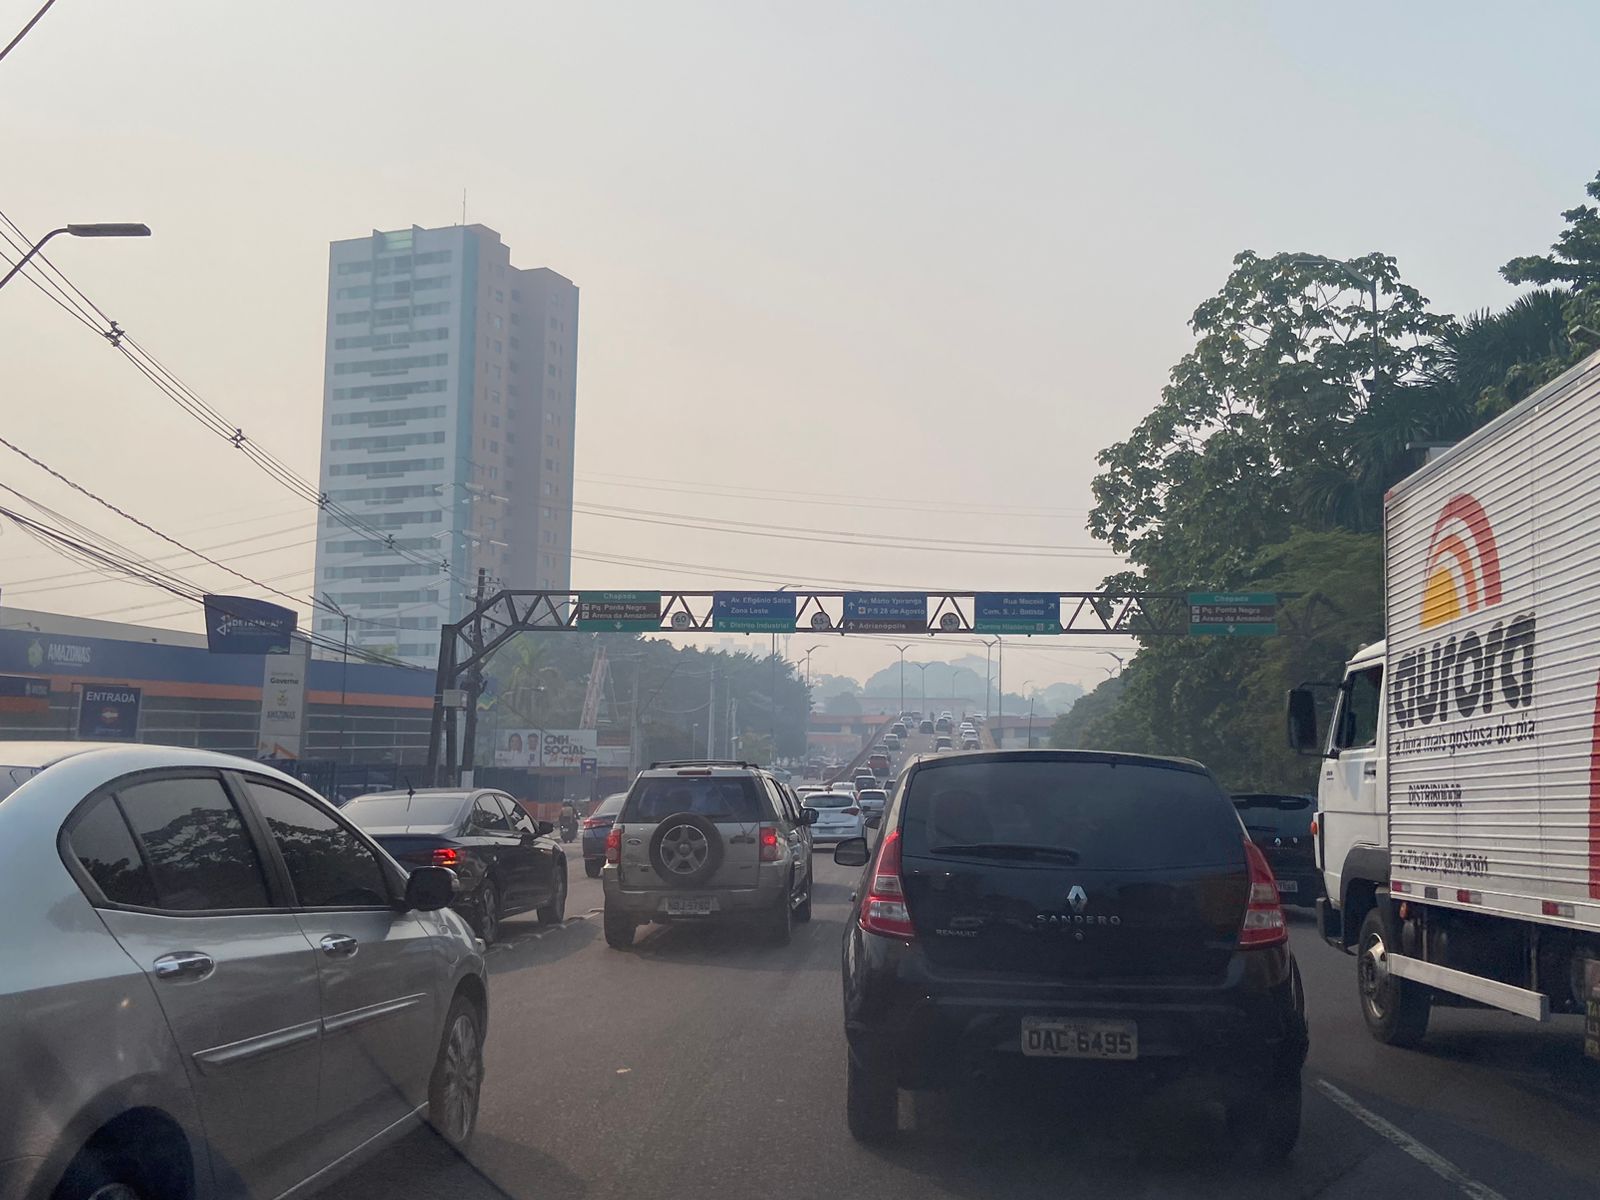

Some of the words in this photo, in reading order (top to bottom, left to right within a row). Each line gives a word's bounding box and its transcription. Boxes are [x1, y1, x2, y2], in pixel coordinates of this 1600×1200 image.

[900, 608, 925, 616] Agosto
[47, 643, 91, 664] AMAZONAS
[1394, 612, 1537, 729] aurora
[86, 691, 136, 704] ENTRADA
[544, 735, 569, 745] CNH
[544, 745, 586, 755] SOCIAL
[1036, 914, 1122, 926] SANDERO
[936, 929, 977, 938] RENAULT
